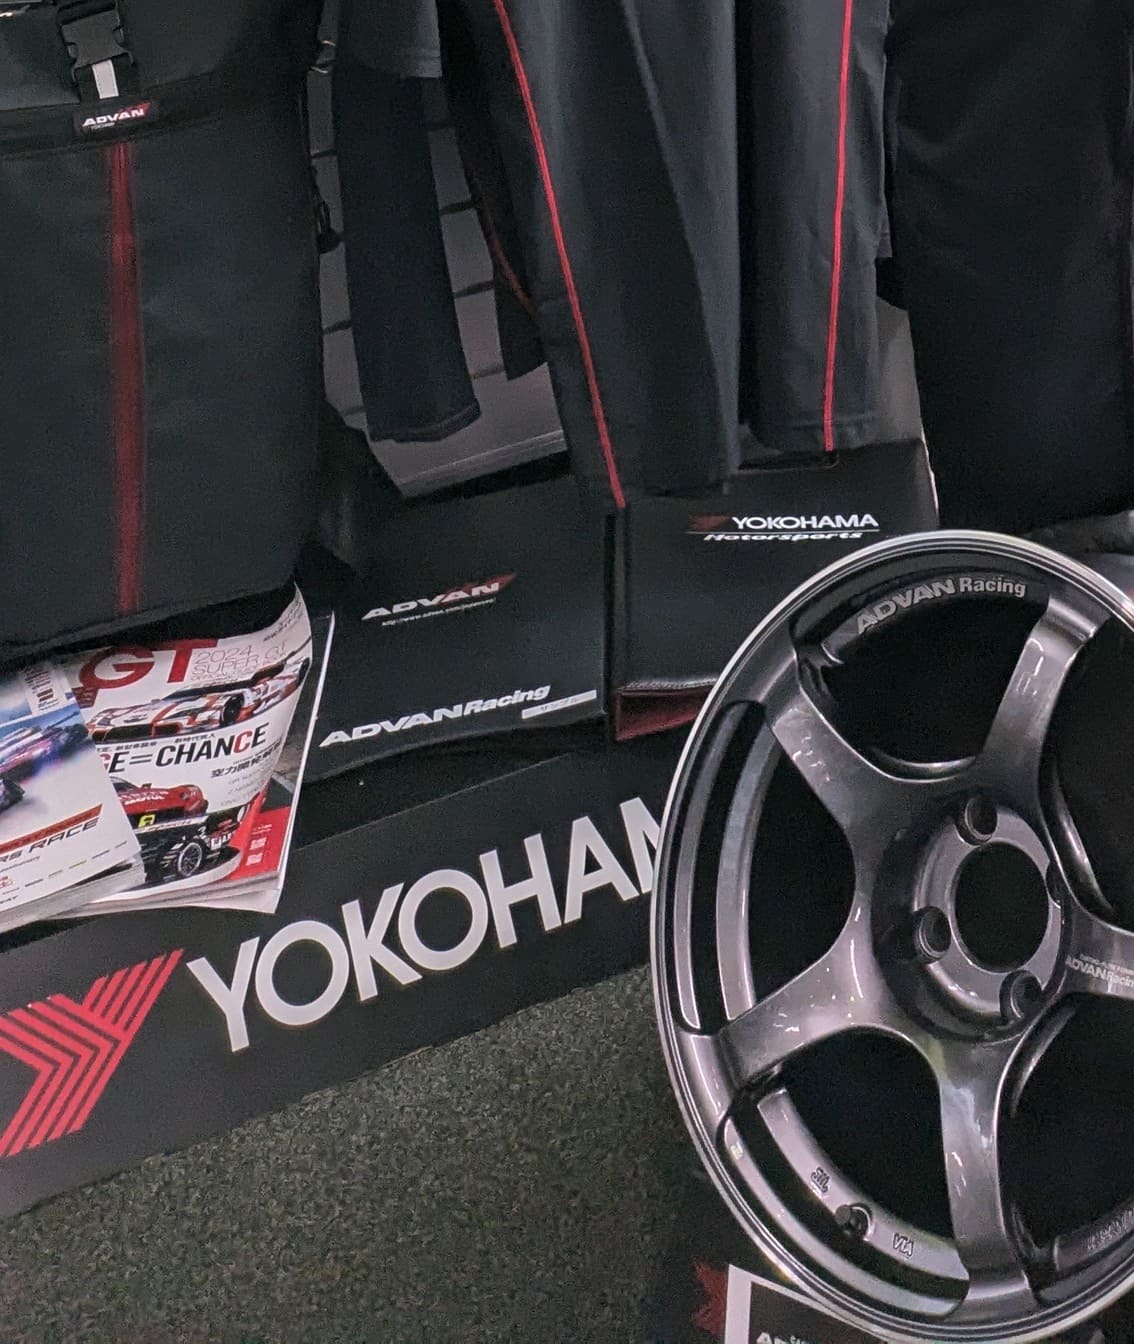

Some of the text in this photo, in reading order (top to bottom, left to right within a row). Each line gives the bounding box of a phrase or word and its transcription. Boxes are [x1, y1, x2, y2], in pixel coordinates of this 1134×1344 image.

[82, 108, 145, 127] ADVAN
[731, 514, 880, 530] YOKOHAMA
[703, 532, 864, 542] Motorsports
[361, 582, 501, 621] ADVAN
[857, 576, 1027, 635] ADVAN Racing
[79, 638, 218, 689] GT
[191, 654, 260, 676] SUPER
[195, 645, 253, 665] 2024
[28, 817, 99, 853] RACE
